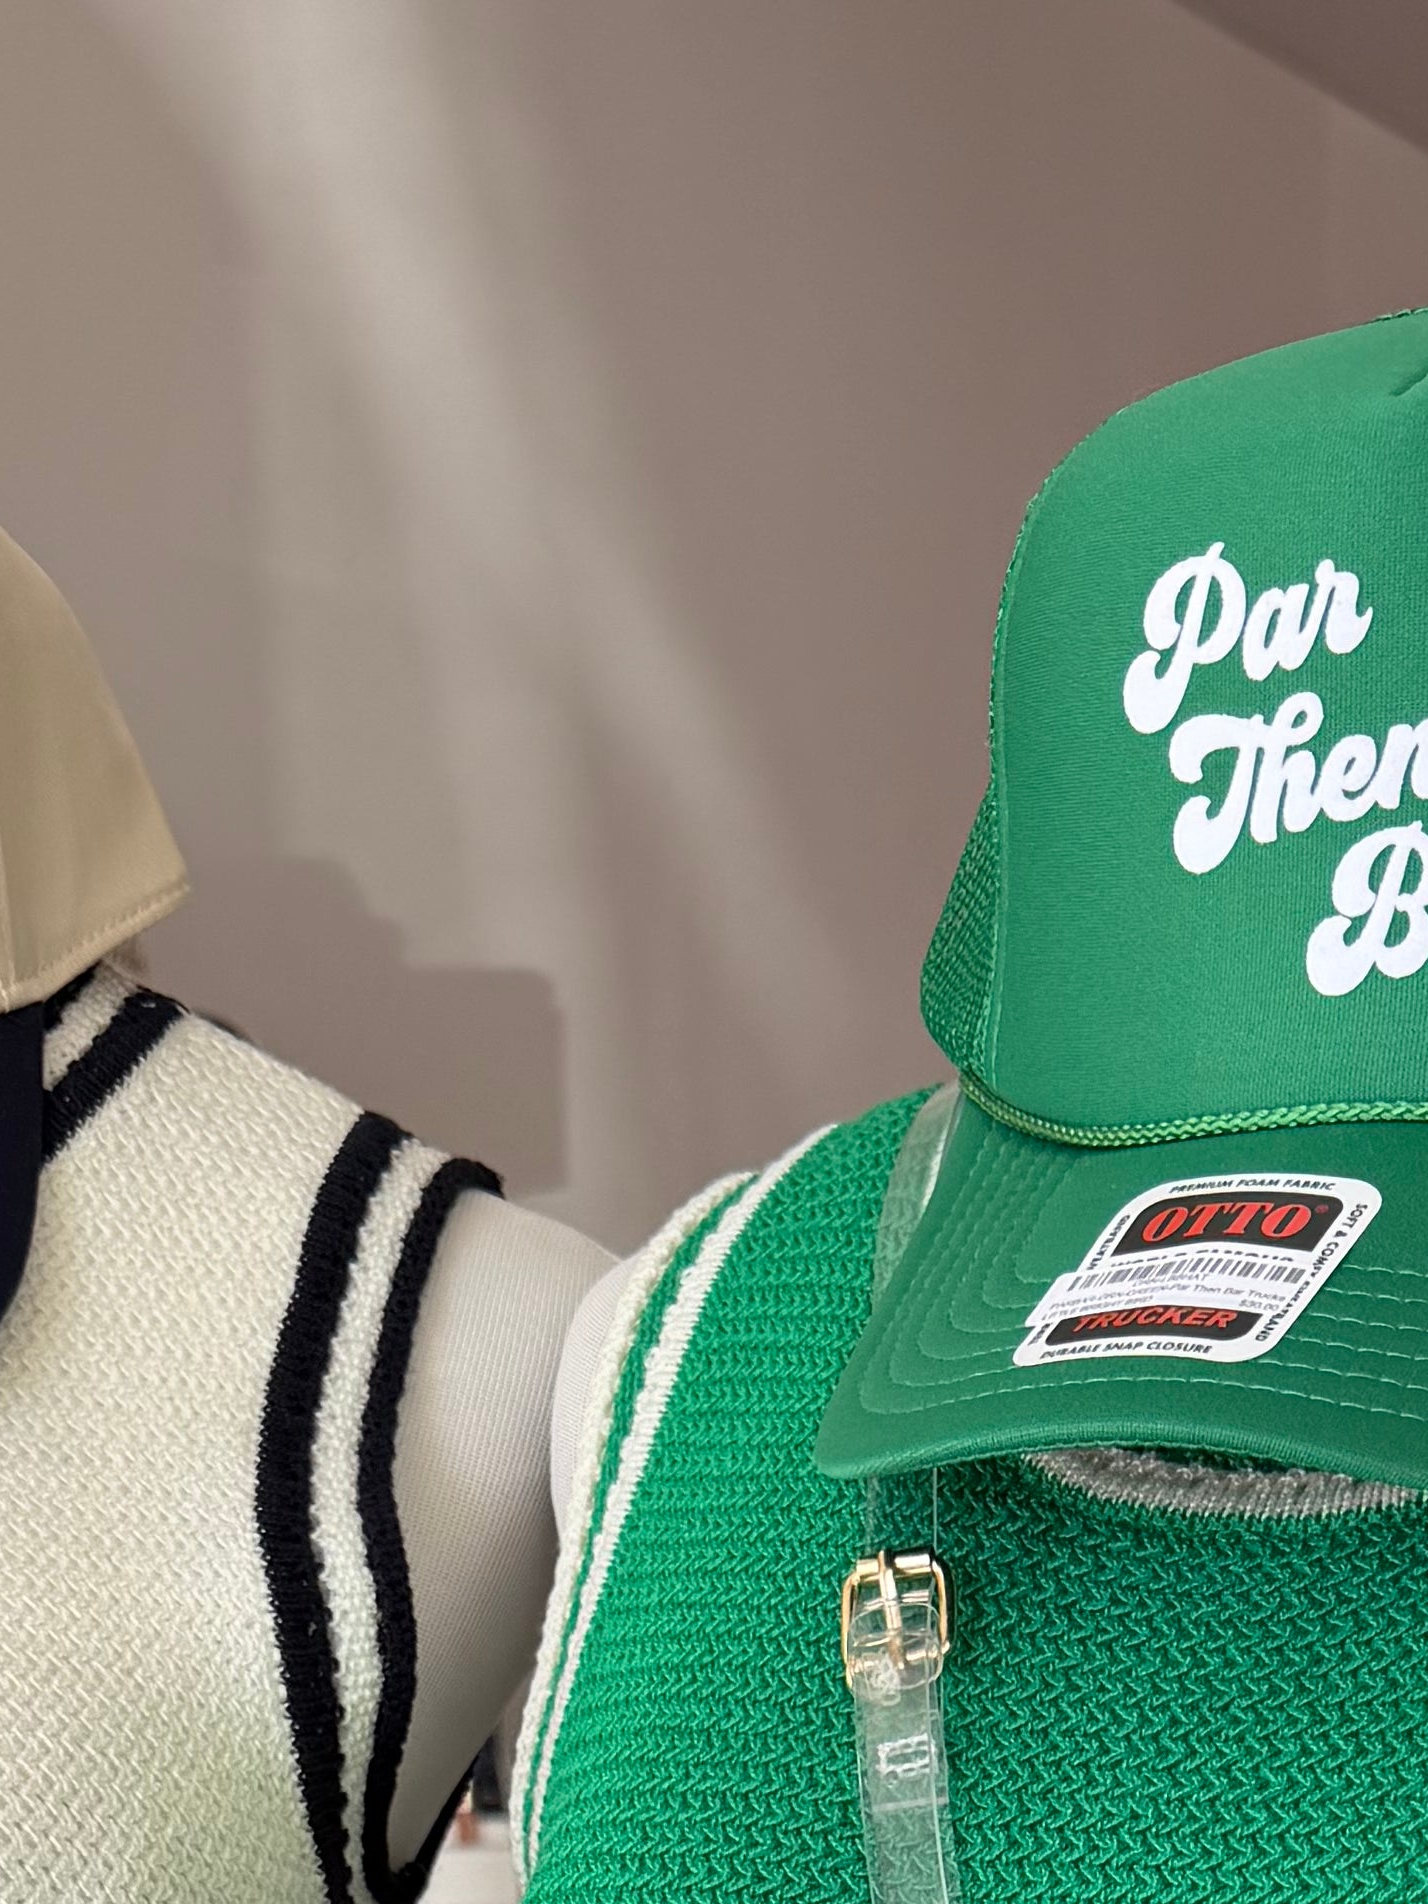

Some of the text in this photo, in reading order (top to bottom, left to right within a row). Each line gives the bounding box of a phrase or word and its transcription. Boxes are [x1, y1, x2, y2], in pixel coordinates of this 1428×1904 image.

[1123, 542, 1373, 734] Par
[1169, 1179, 1336, 1194] PREMIUM FOAM FABRIC
[1142, 1202, 1312, 1243] OTTO
[1343, 1204, 1368, 1229] SOFT
[1086, 1215, 1130, 1270] WEATBAND
[1073, 1306, 1238, 1333] TRUCKER
[1040, 1341, 1213, 1359] DURABLE SNAP CLOSURE
